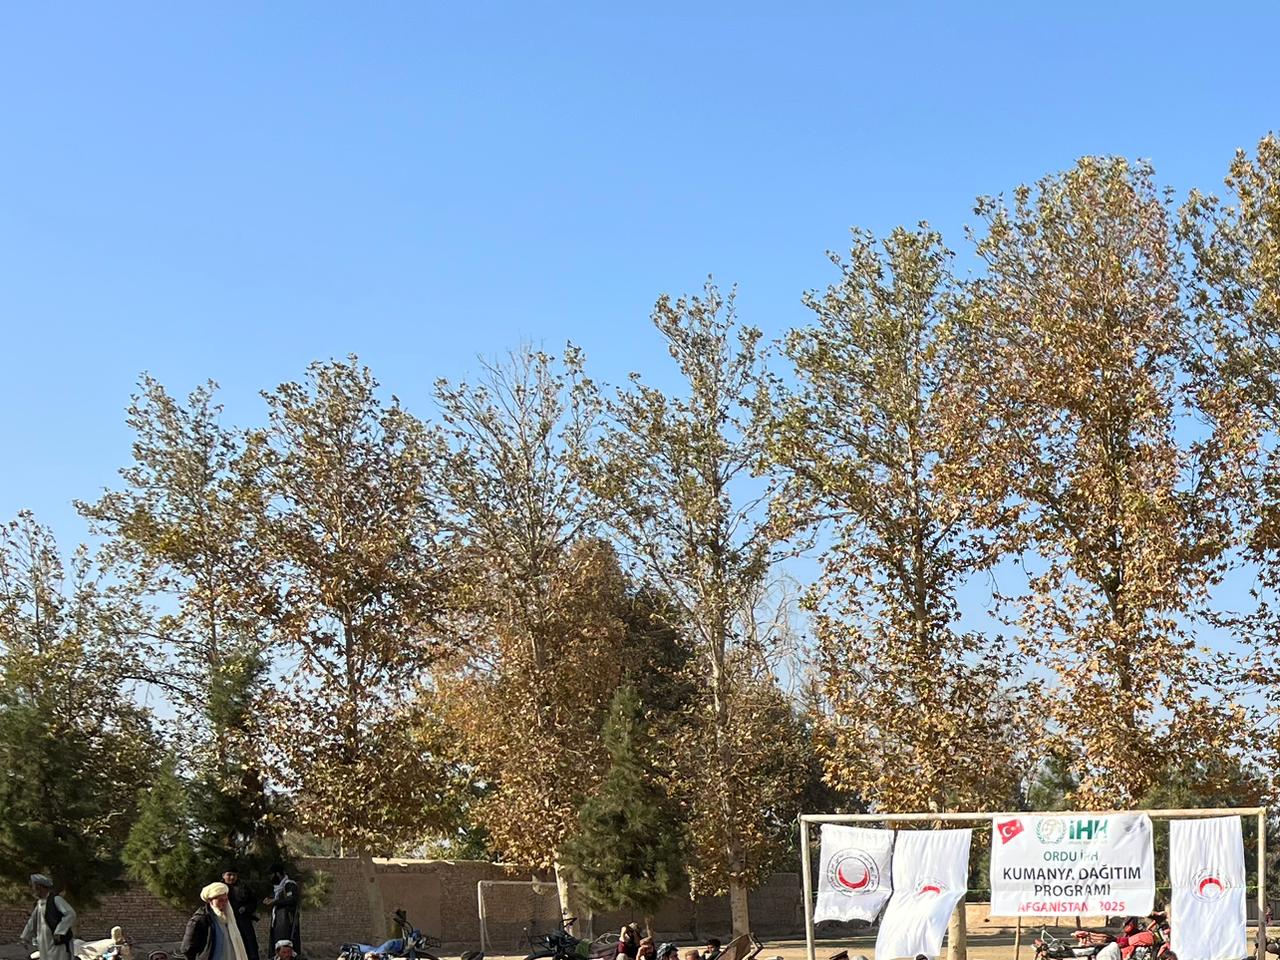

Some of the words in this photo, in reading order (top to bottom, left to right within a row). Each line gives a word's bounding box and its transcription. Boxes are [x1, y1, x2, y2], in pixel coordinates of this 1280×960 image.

[1043, 851, 1077, 862] ORDU
[1003, 867, 1075, 880] KUMANYA
[1078, 864, 1141, 880] DAĞITIM
[1034, 884, 1111, 896] PROGRAMI
